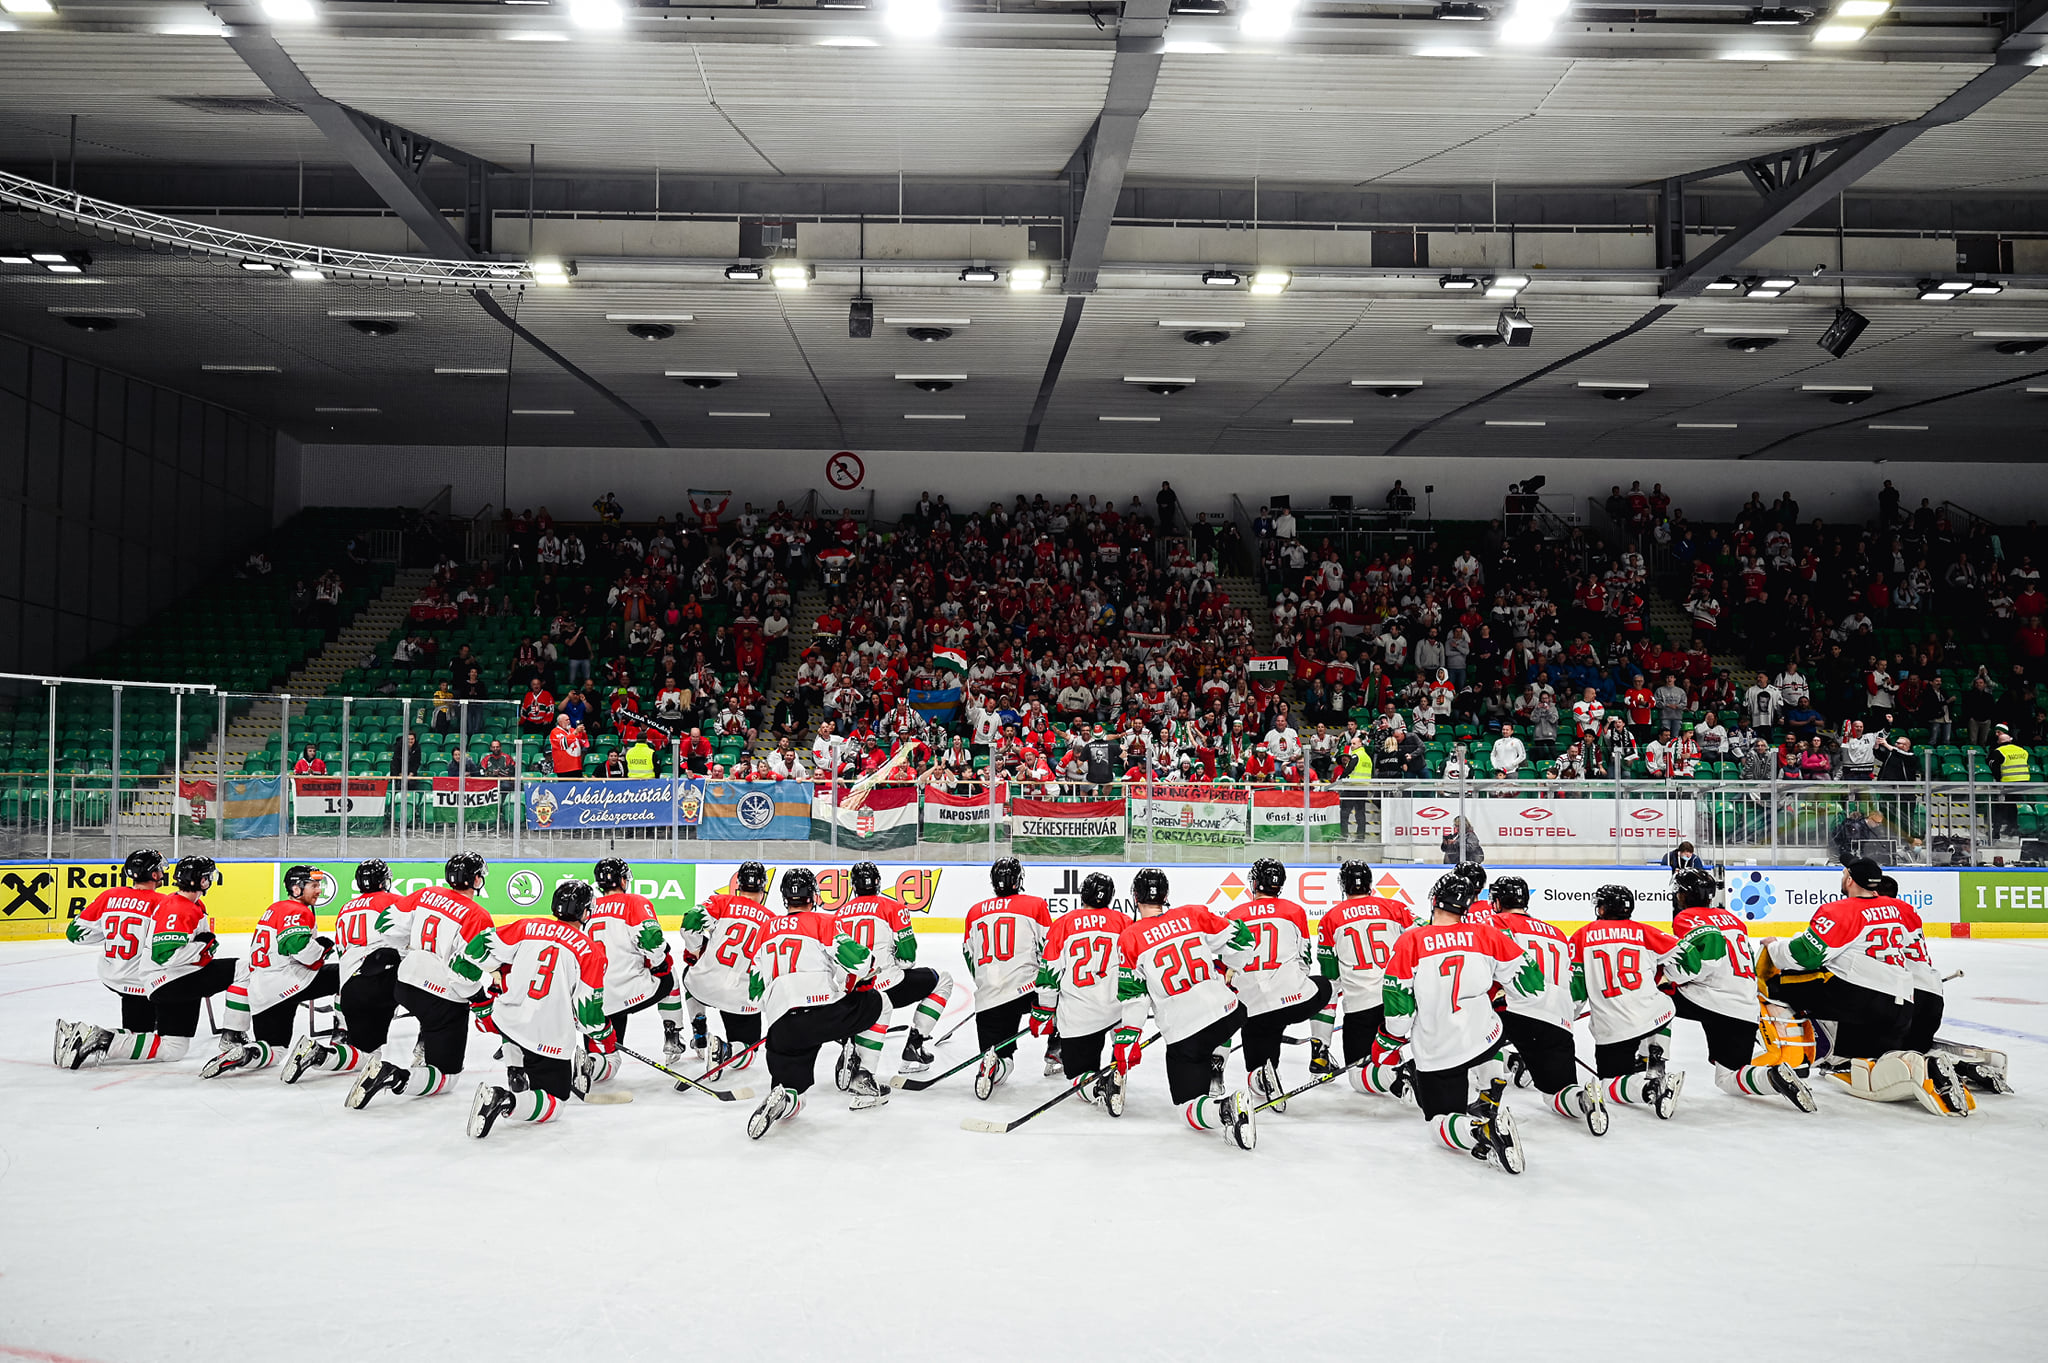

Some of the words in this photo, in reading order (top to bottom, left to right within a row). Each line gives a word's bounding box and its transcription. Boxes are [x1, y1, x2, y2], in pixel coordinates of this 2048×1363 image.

[560, 780, 672, 806] Lokálpatrióták
[324, 798, 354, 814] 19
[939, 808, 990, 821] KAPOSVÁR
[579, 808, 656, 826] Csíkszereda
[1152, 816, 1180, 826] GREEN
[1022, 817, 1117, 836] SZÉKESFEHÉRVÁR
[1499, 827, 1576, 837] BIOSTEEL
[1609, 827, 1687, 838] BIOSTEEL
[791, 886, 798, 894] 17
[1976, 886, 1988, 908] I
[106, 896, 150, 913] MAGOSI
[420, 890, 470, 920] SARPATKI
[643, 904, 654, 917] 6
[838, 901, 879, 917] SOFRON
[981, 898, 1012, 914] NAGY
[1248, 903, 1276, 916] VAS
[1342, 904, 1380, 920] KOGER
[166, 914, 178, 930] 2
[769, 916, 798, 935] KISS
[1074, 914, 1107, 931] PAPP
[1142, 916, 1192, 945] ERDELY
[1525, 919, 1557, 937] TOTH
[104, 915, 142, 960] 25
[420, 914, 442, 954] 8
[525, 921, 592, 958] MACAULAY
[977, 916, 1016, 967] 10
[1423, 931, 1475, 951] GARAT
[1586, 928, 1644, 943] KULMALA
[1343, 922, 1390, 971] 16
[766, 937, 802, 981] 17
[1069, 936, 1113, 989] 27
[1152, 935, 1211, 997] 26
[1528, 940, 1561, 986] 11
[527, 944, 560, 1001] 3
[1593, 947, 1643, 999] 18
[427, 982, 446, 995] IIHF
[1438, 954, 1465, 1014] 7
[628, 993, 646, 1007] IIHF
[811, 995, 830, 1003] IIHF
[1285, 993, 1303, 1005] IIHF
[542, 1045, 562, 1056] IIHF
